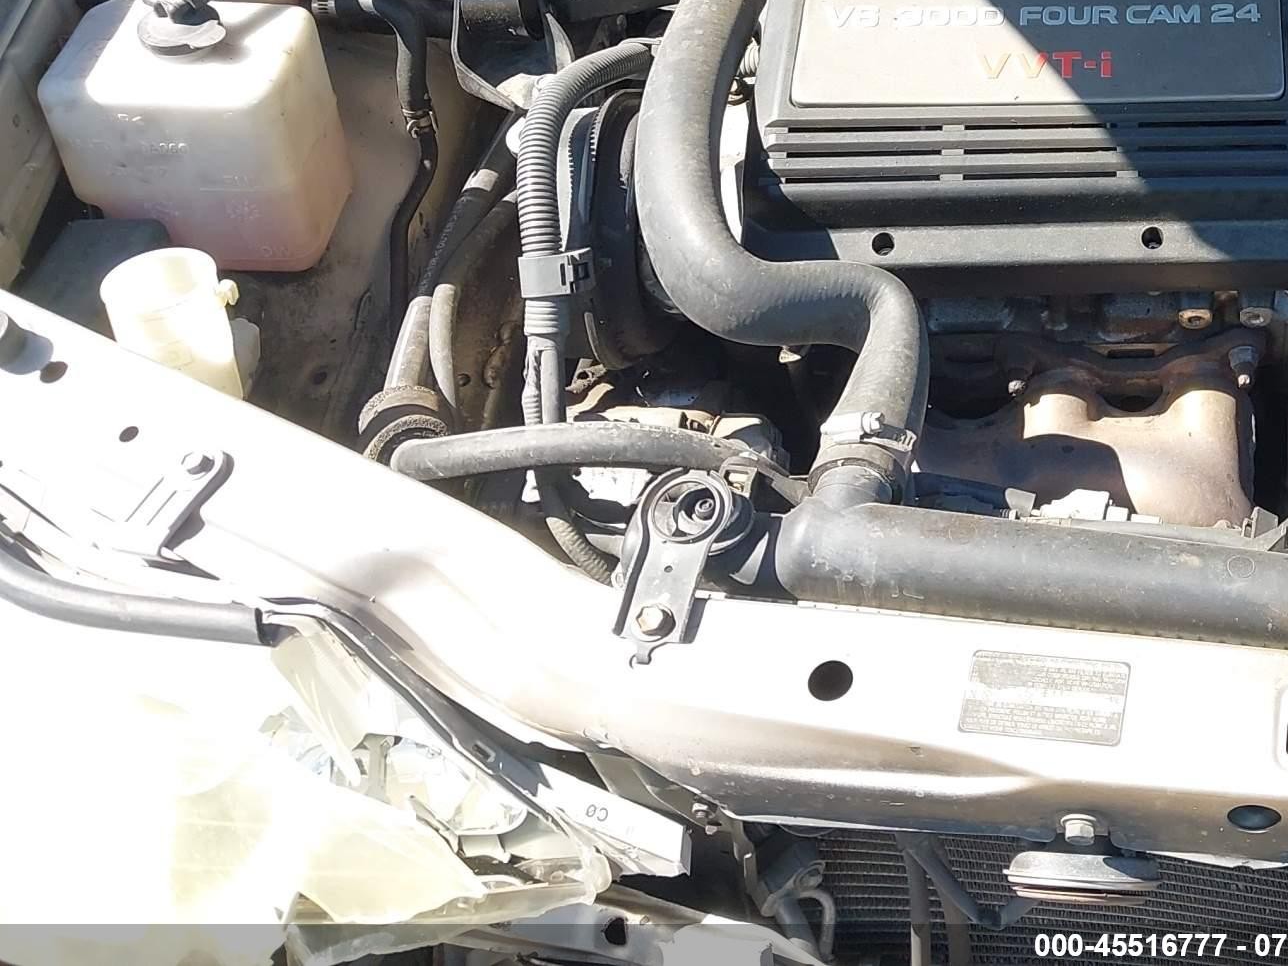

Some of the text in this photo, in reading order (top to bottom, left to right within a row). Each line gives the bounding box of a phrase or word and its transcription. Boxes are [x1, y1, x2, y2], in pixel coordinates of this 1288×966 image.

[1019, 5, 1119, 26] FOUR
[1125, 4, 1201, 25] CAM
[1210, 3, 1262, 24] 24
[980, 51, 1113, 79] VVT-i
